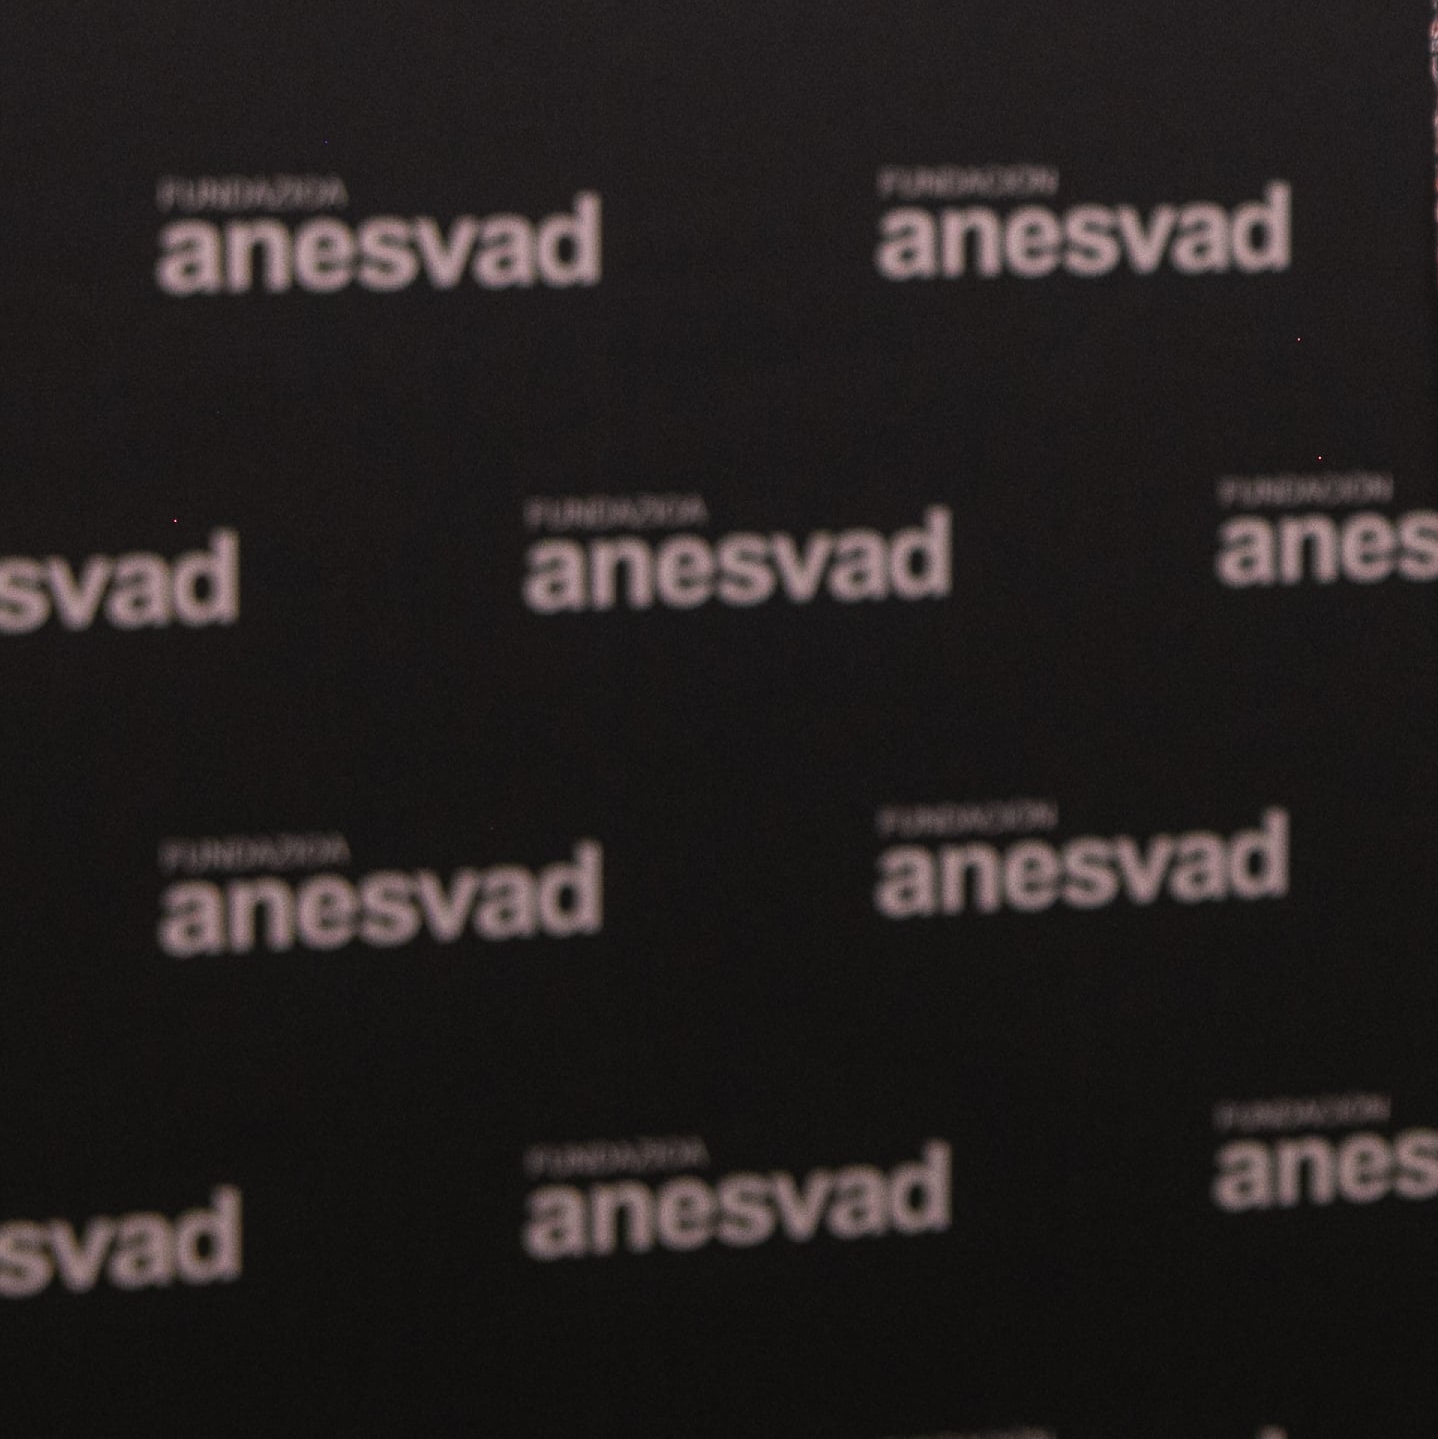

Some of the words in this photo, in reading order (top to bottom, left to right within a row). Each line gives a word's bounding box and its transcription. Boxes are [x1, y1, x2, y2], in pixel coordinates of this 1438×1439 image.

[158, 193, 600, 295] anesvad
[878, 182, 1290, 280] anesvad
[0, 528, 239, 633] svad
[525, 507, 950, 612] anesvad
[161, 842, 601, 956] anesvad
[877, 809, 1287, 917] anesvad
[0, 1186, 241, 1295] svad
[526, 1142, 949, 1259] anesvad
